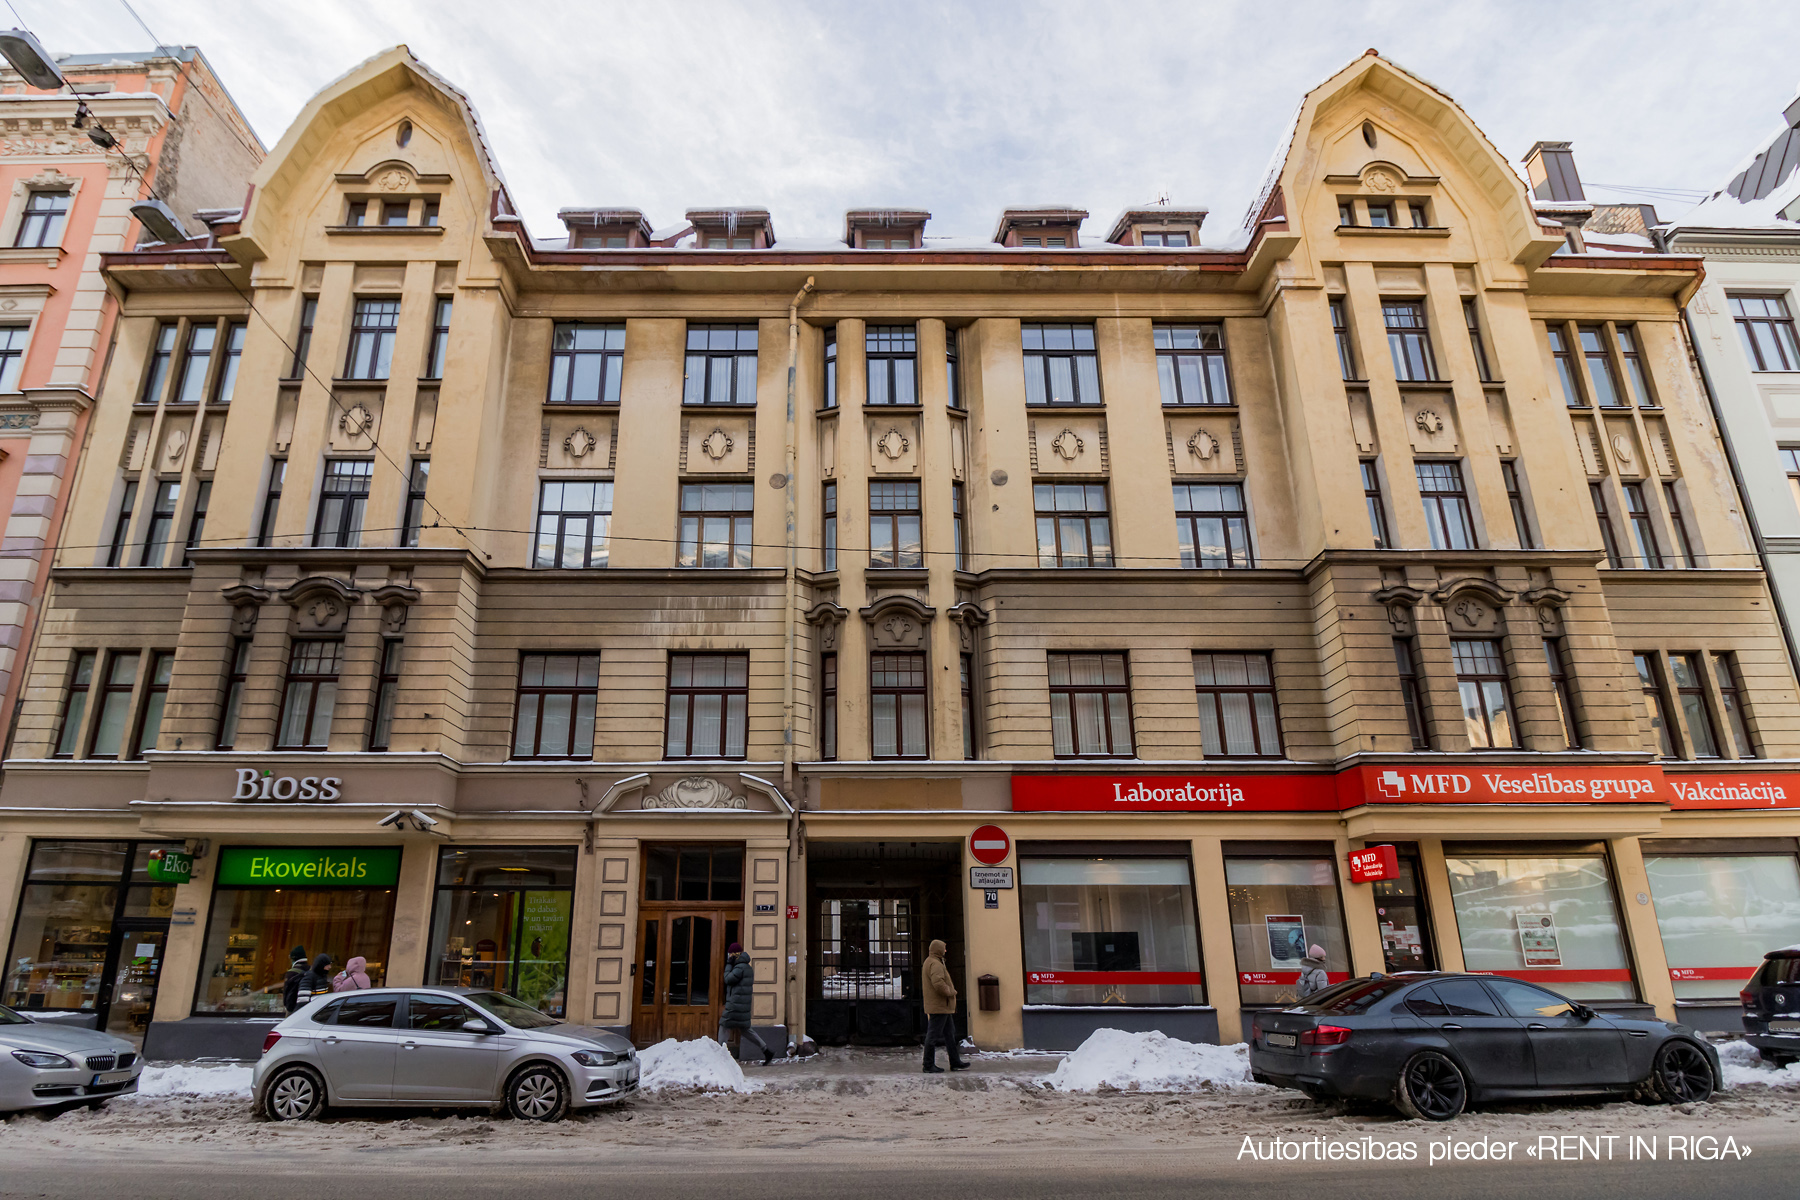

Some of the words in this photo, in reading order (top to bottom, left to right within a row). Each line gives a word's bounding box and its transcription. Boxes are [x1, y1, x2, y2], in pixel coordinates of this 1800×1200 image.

[232, 768, 342, 800] Bioss
[1113, 782, 1245, 807] Laboratorija
[1410, 774, 1471, 794] MFD
[1482, 773, 1586, 794] Veselības
[1589, 778, 1655, 799] grupa
[1670, 782, 1787, 804] Vakcinācija
[250, 857, 367, 878] Ekoveikals
[1361, 853, 1376, 863] MFD
[986, 892, 997, 901] 70
